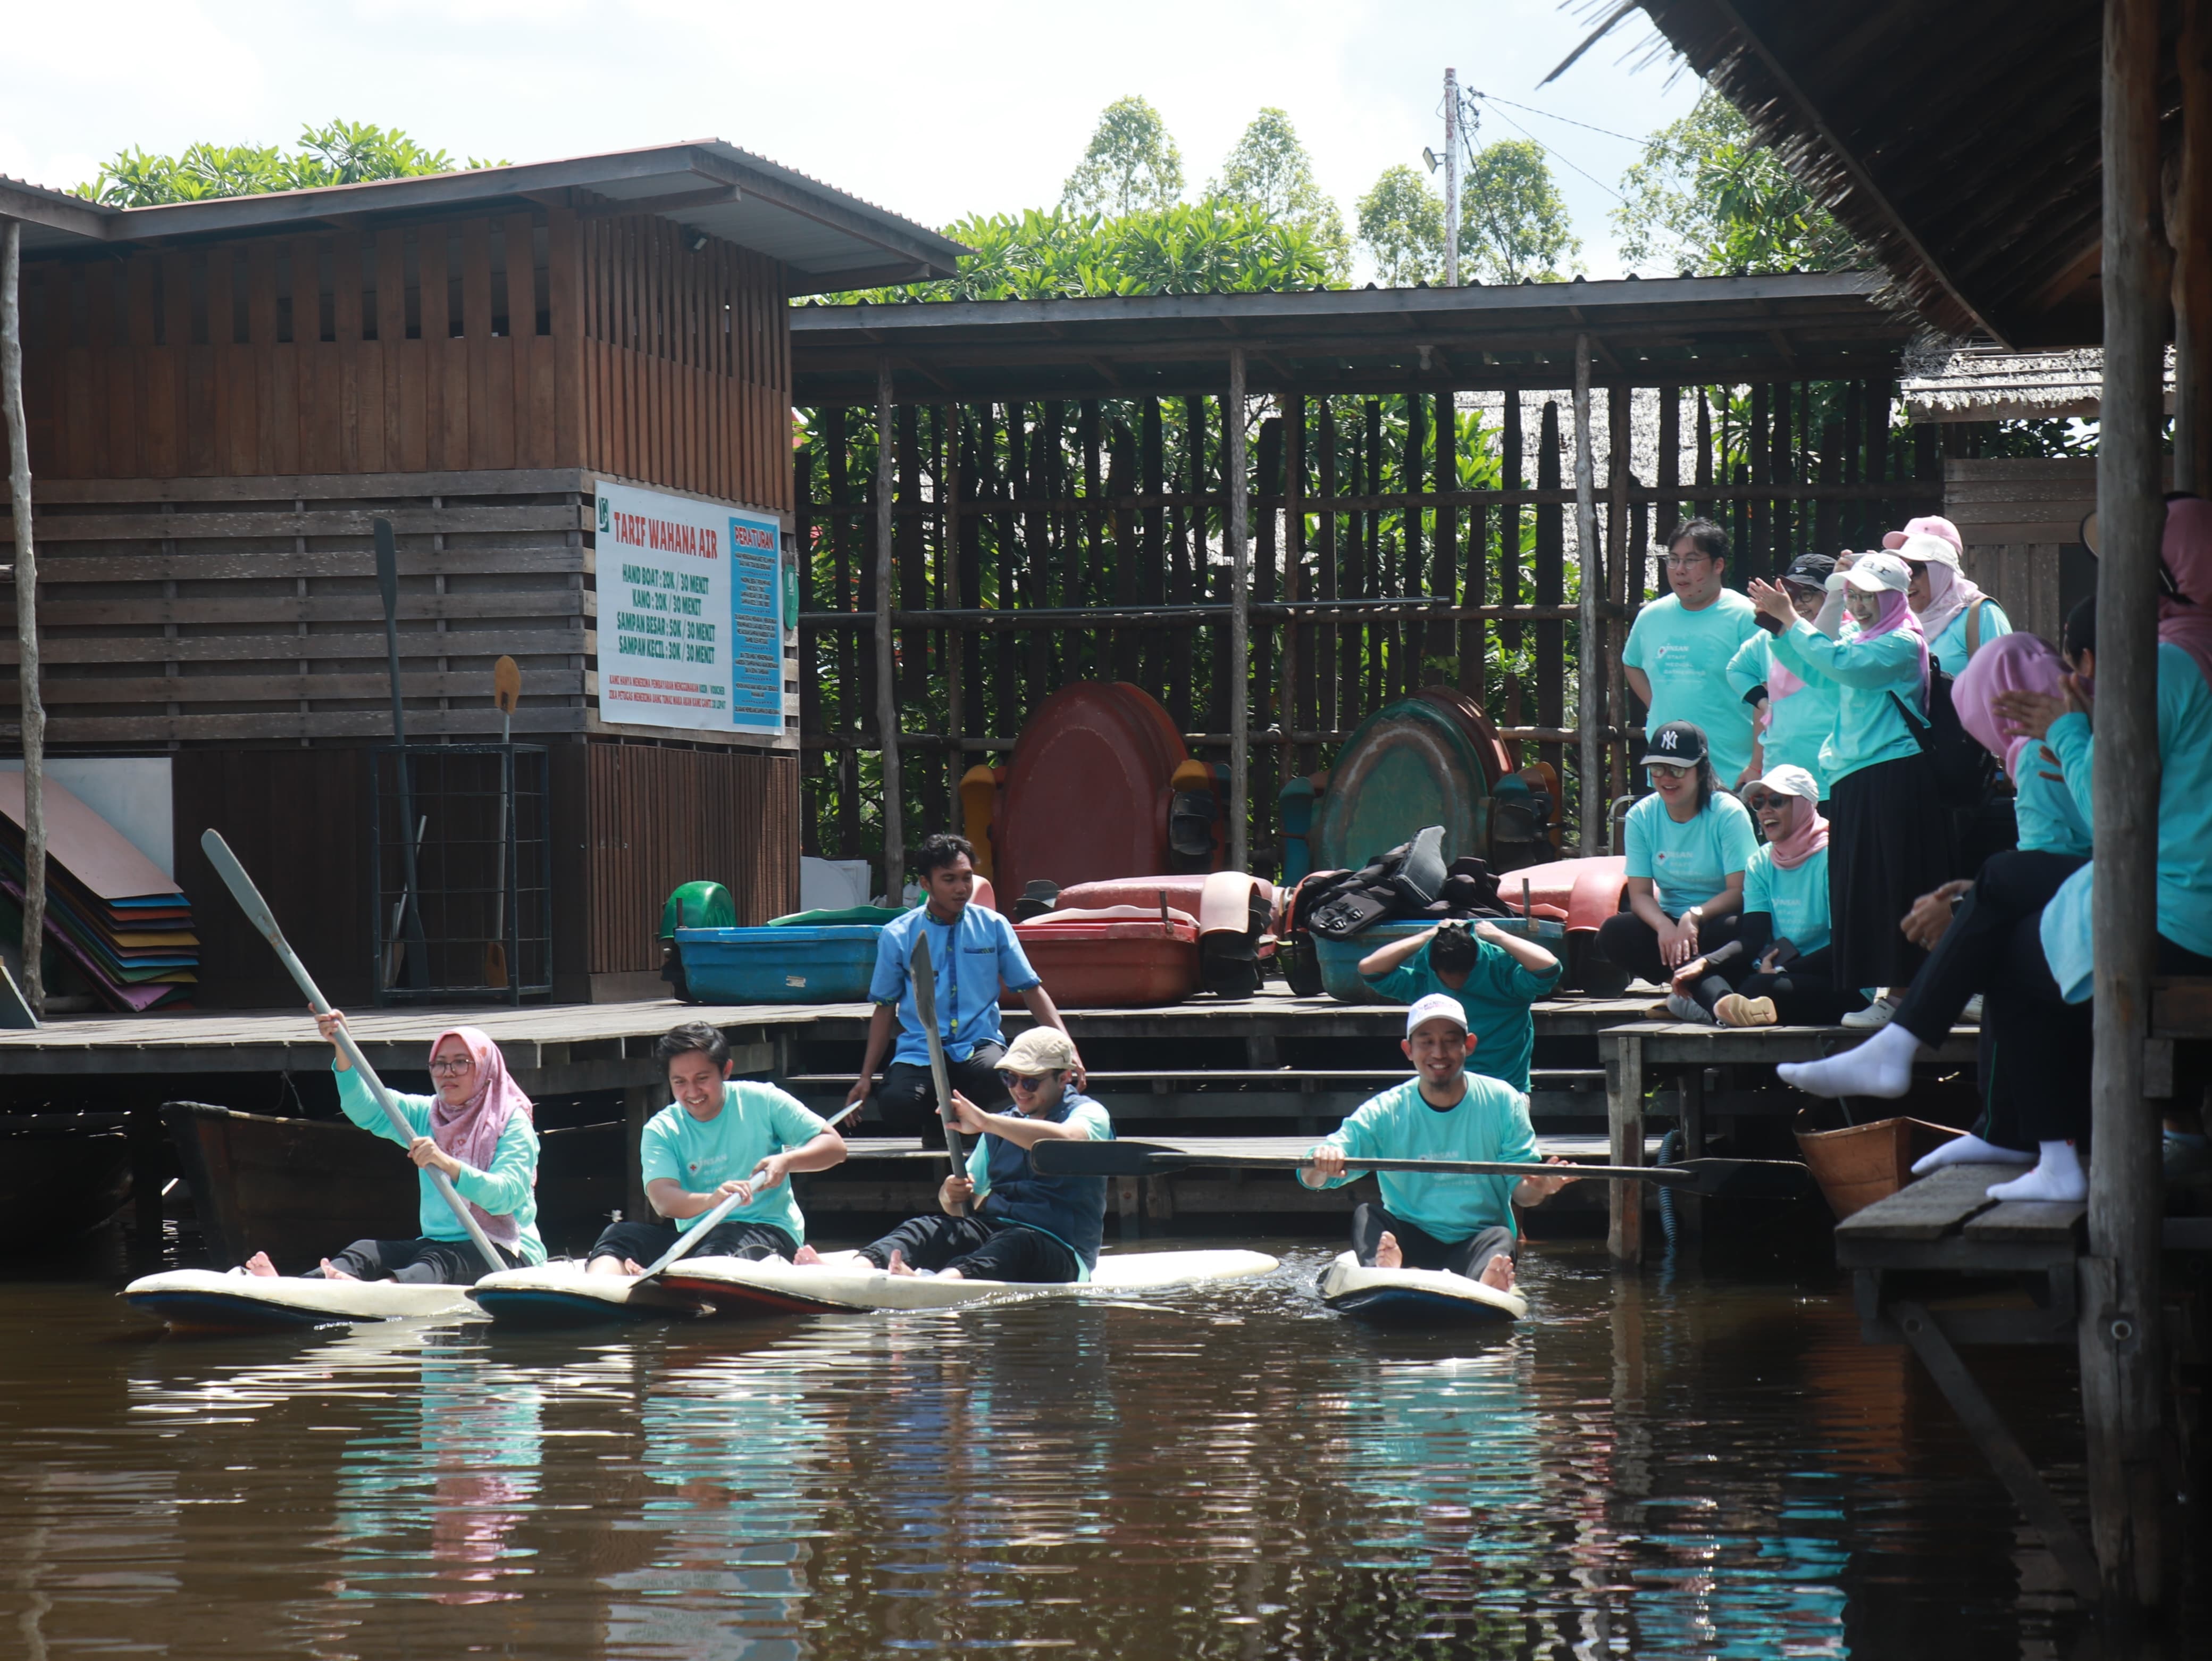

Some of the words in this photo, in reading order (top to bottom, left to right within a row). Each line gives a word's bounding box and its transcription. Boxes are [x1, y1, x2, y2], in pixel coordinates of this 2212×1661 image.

[614, 512, 646, 547] TARIF
[648, 518, 696, 556] WAHANA
[699, 528, 717, 560] AIR
[734, 524, 774, 552] PERATURAN
[623, 564, 641, 585] HAND
[642, 567, 658, 587] BOAT
[663, 570, 675, 589] 20K
[681, 573, 689, 591] 30
[690, 575, 709, 595] MENIT
[632, 588, 651, 609] KANO
[655, 592, 667, 611] 20K
[673, 595, 681, 613] 30
[682, 596, 701, 616] MENIT
[617, 612, 645, 633] SAMPAN
[646, 615, 665, 636] BESAR
[669, 619, 681, 637] 50K
[687, 621, 695, 640] 30
[696, 622, 715, 642] MENIT
[619, 635, 646, 656] SAMPAN
[647, 638, 665, 658] KECIL
[668, 641, 681, 660] 30K
[686, 644, 694, 662] 30
[695, 645, 715, 664] MENIT
[1661, 730, 1678, 750] NY
